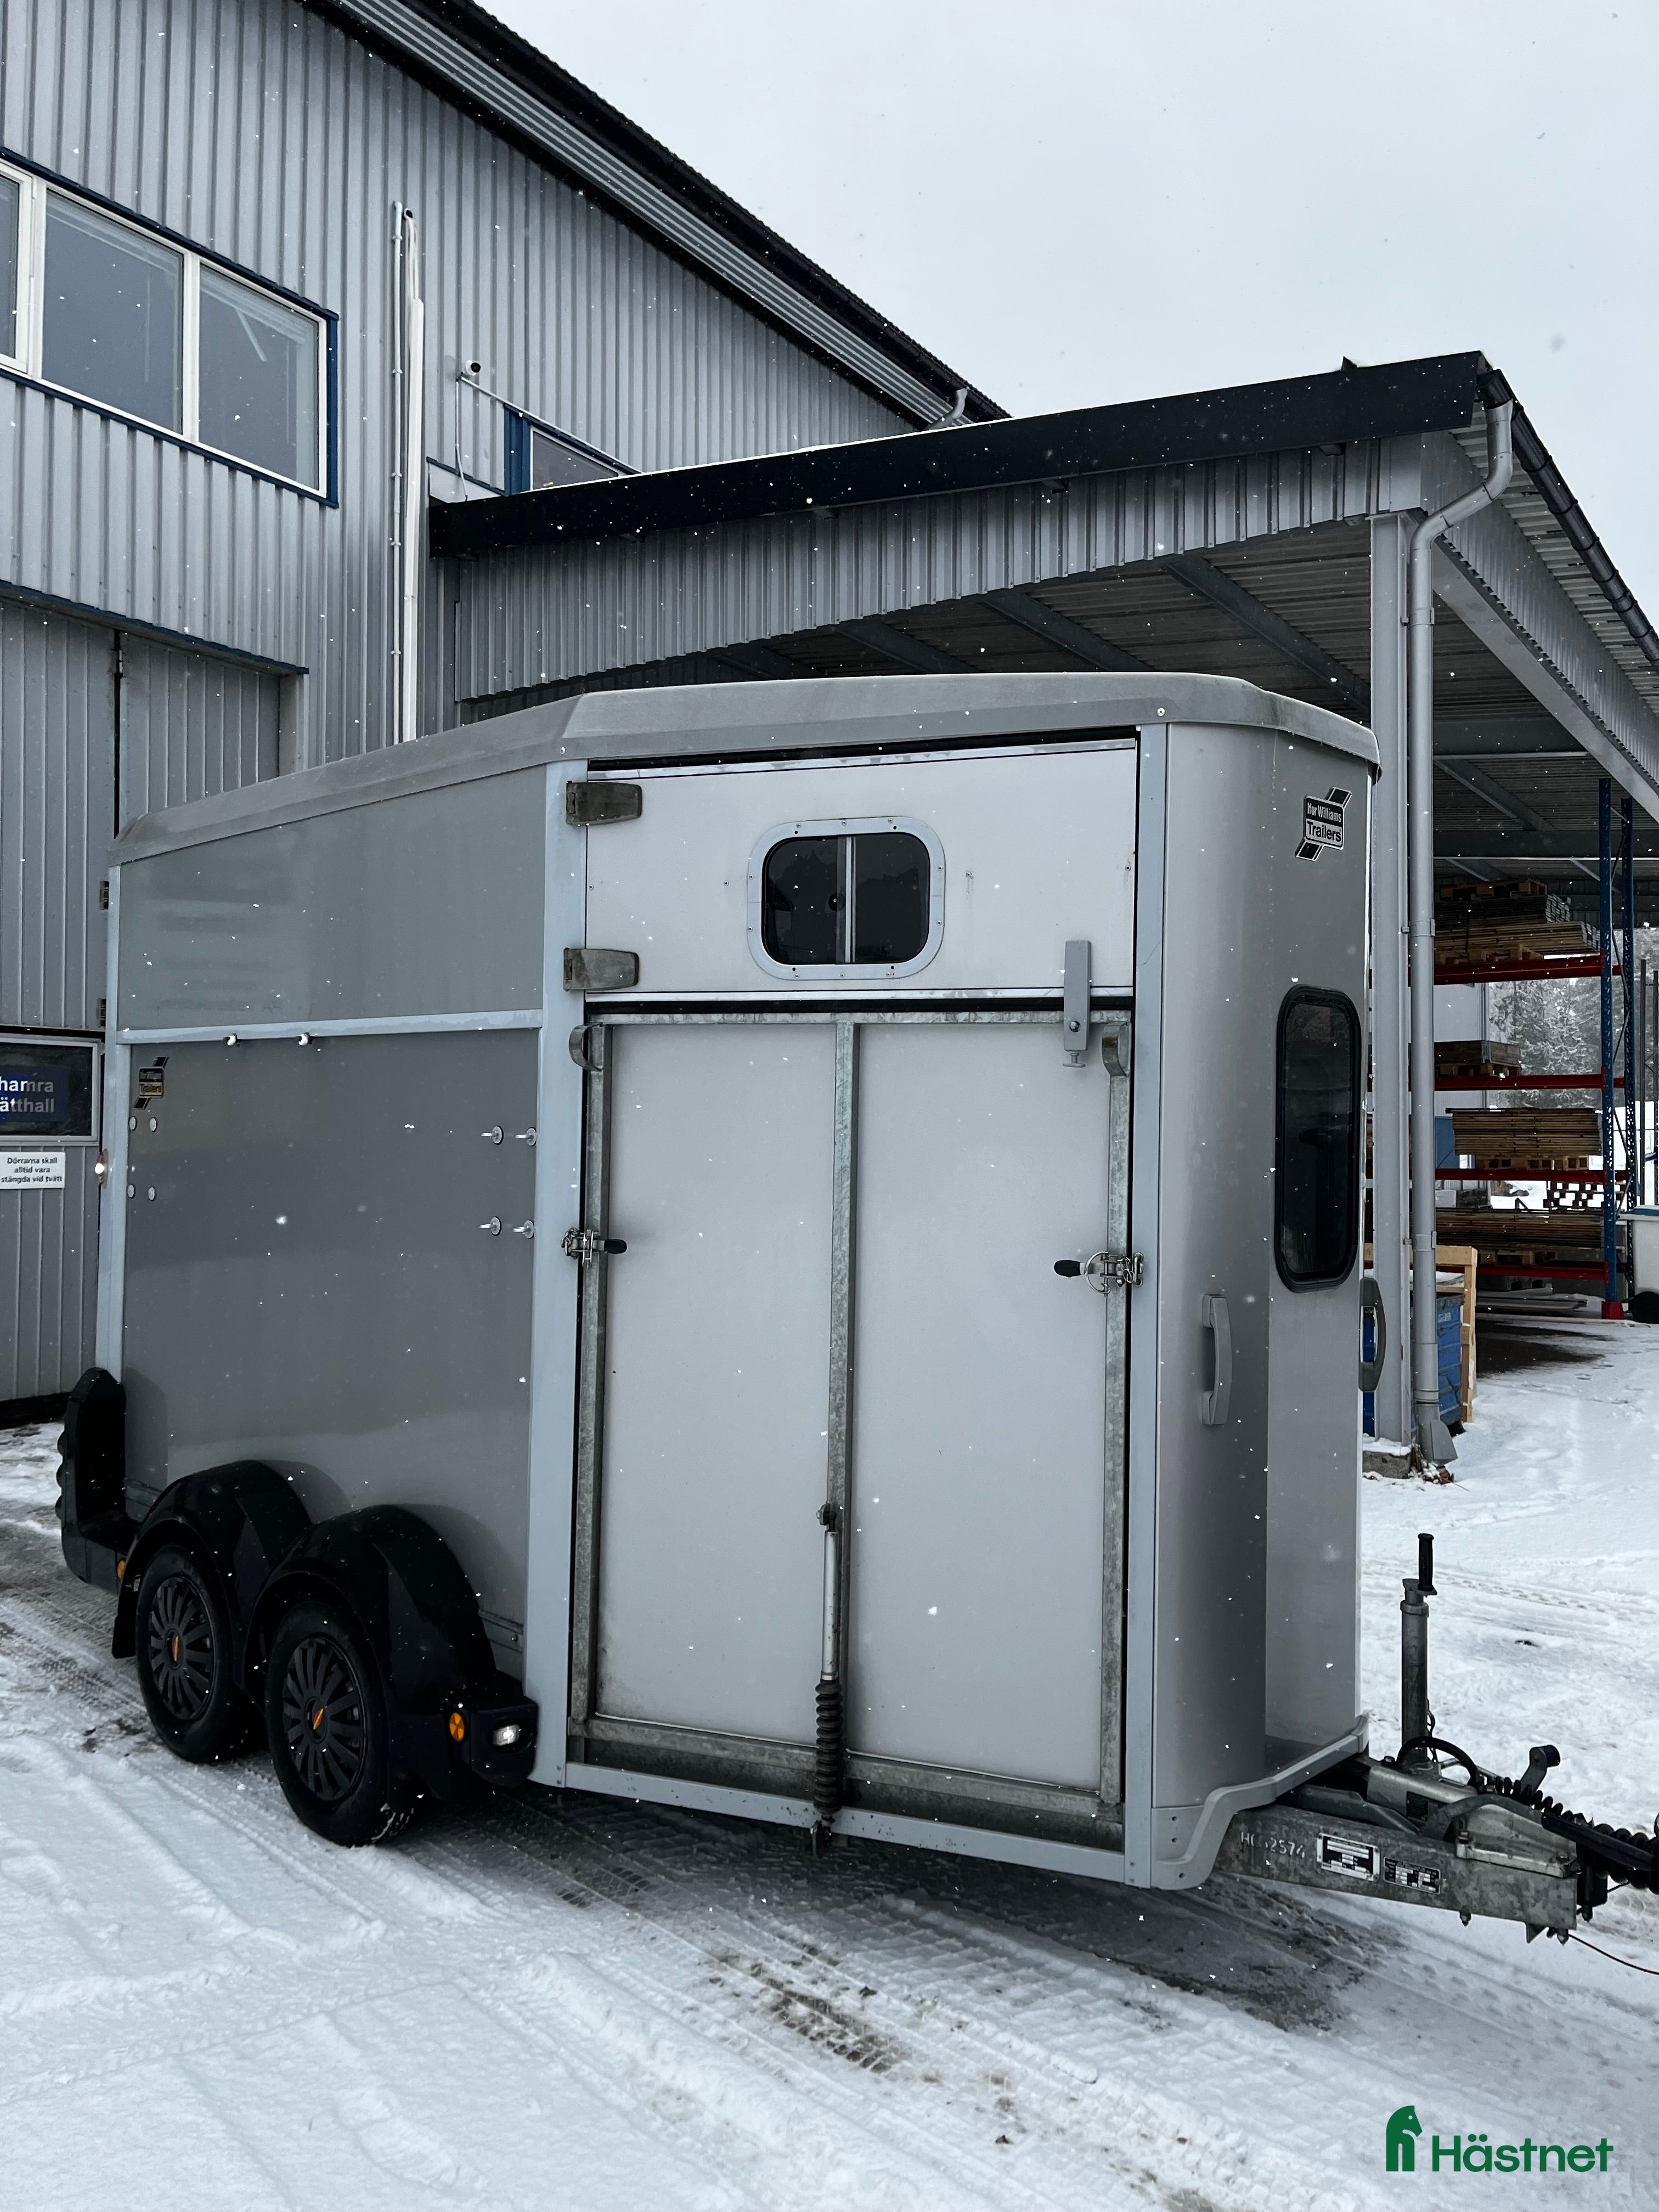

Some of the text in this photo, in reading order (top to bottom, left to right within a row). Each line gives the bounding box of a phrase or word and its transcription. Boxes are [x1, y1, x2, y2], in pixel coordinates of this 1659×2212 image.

[1318, 805, 1341, 822] Williams
[1307, 821, 1341, 842] Trailers
[0, 1076, 53, 1092] hamra
